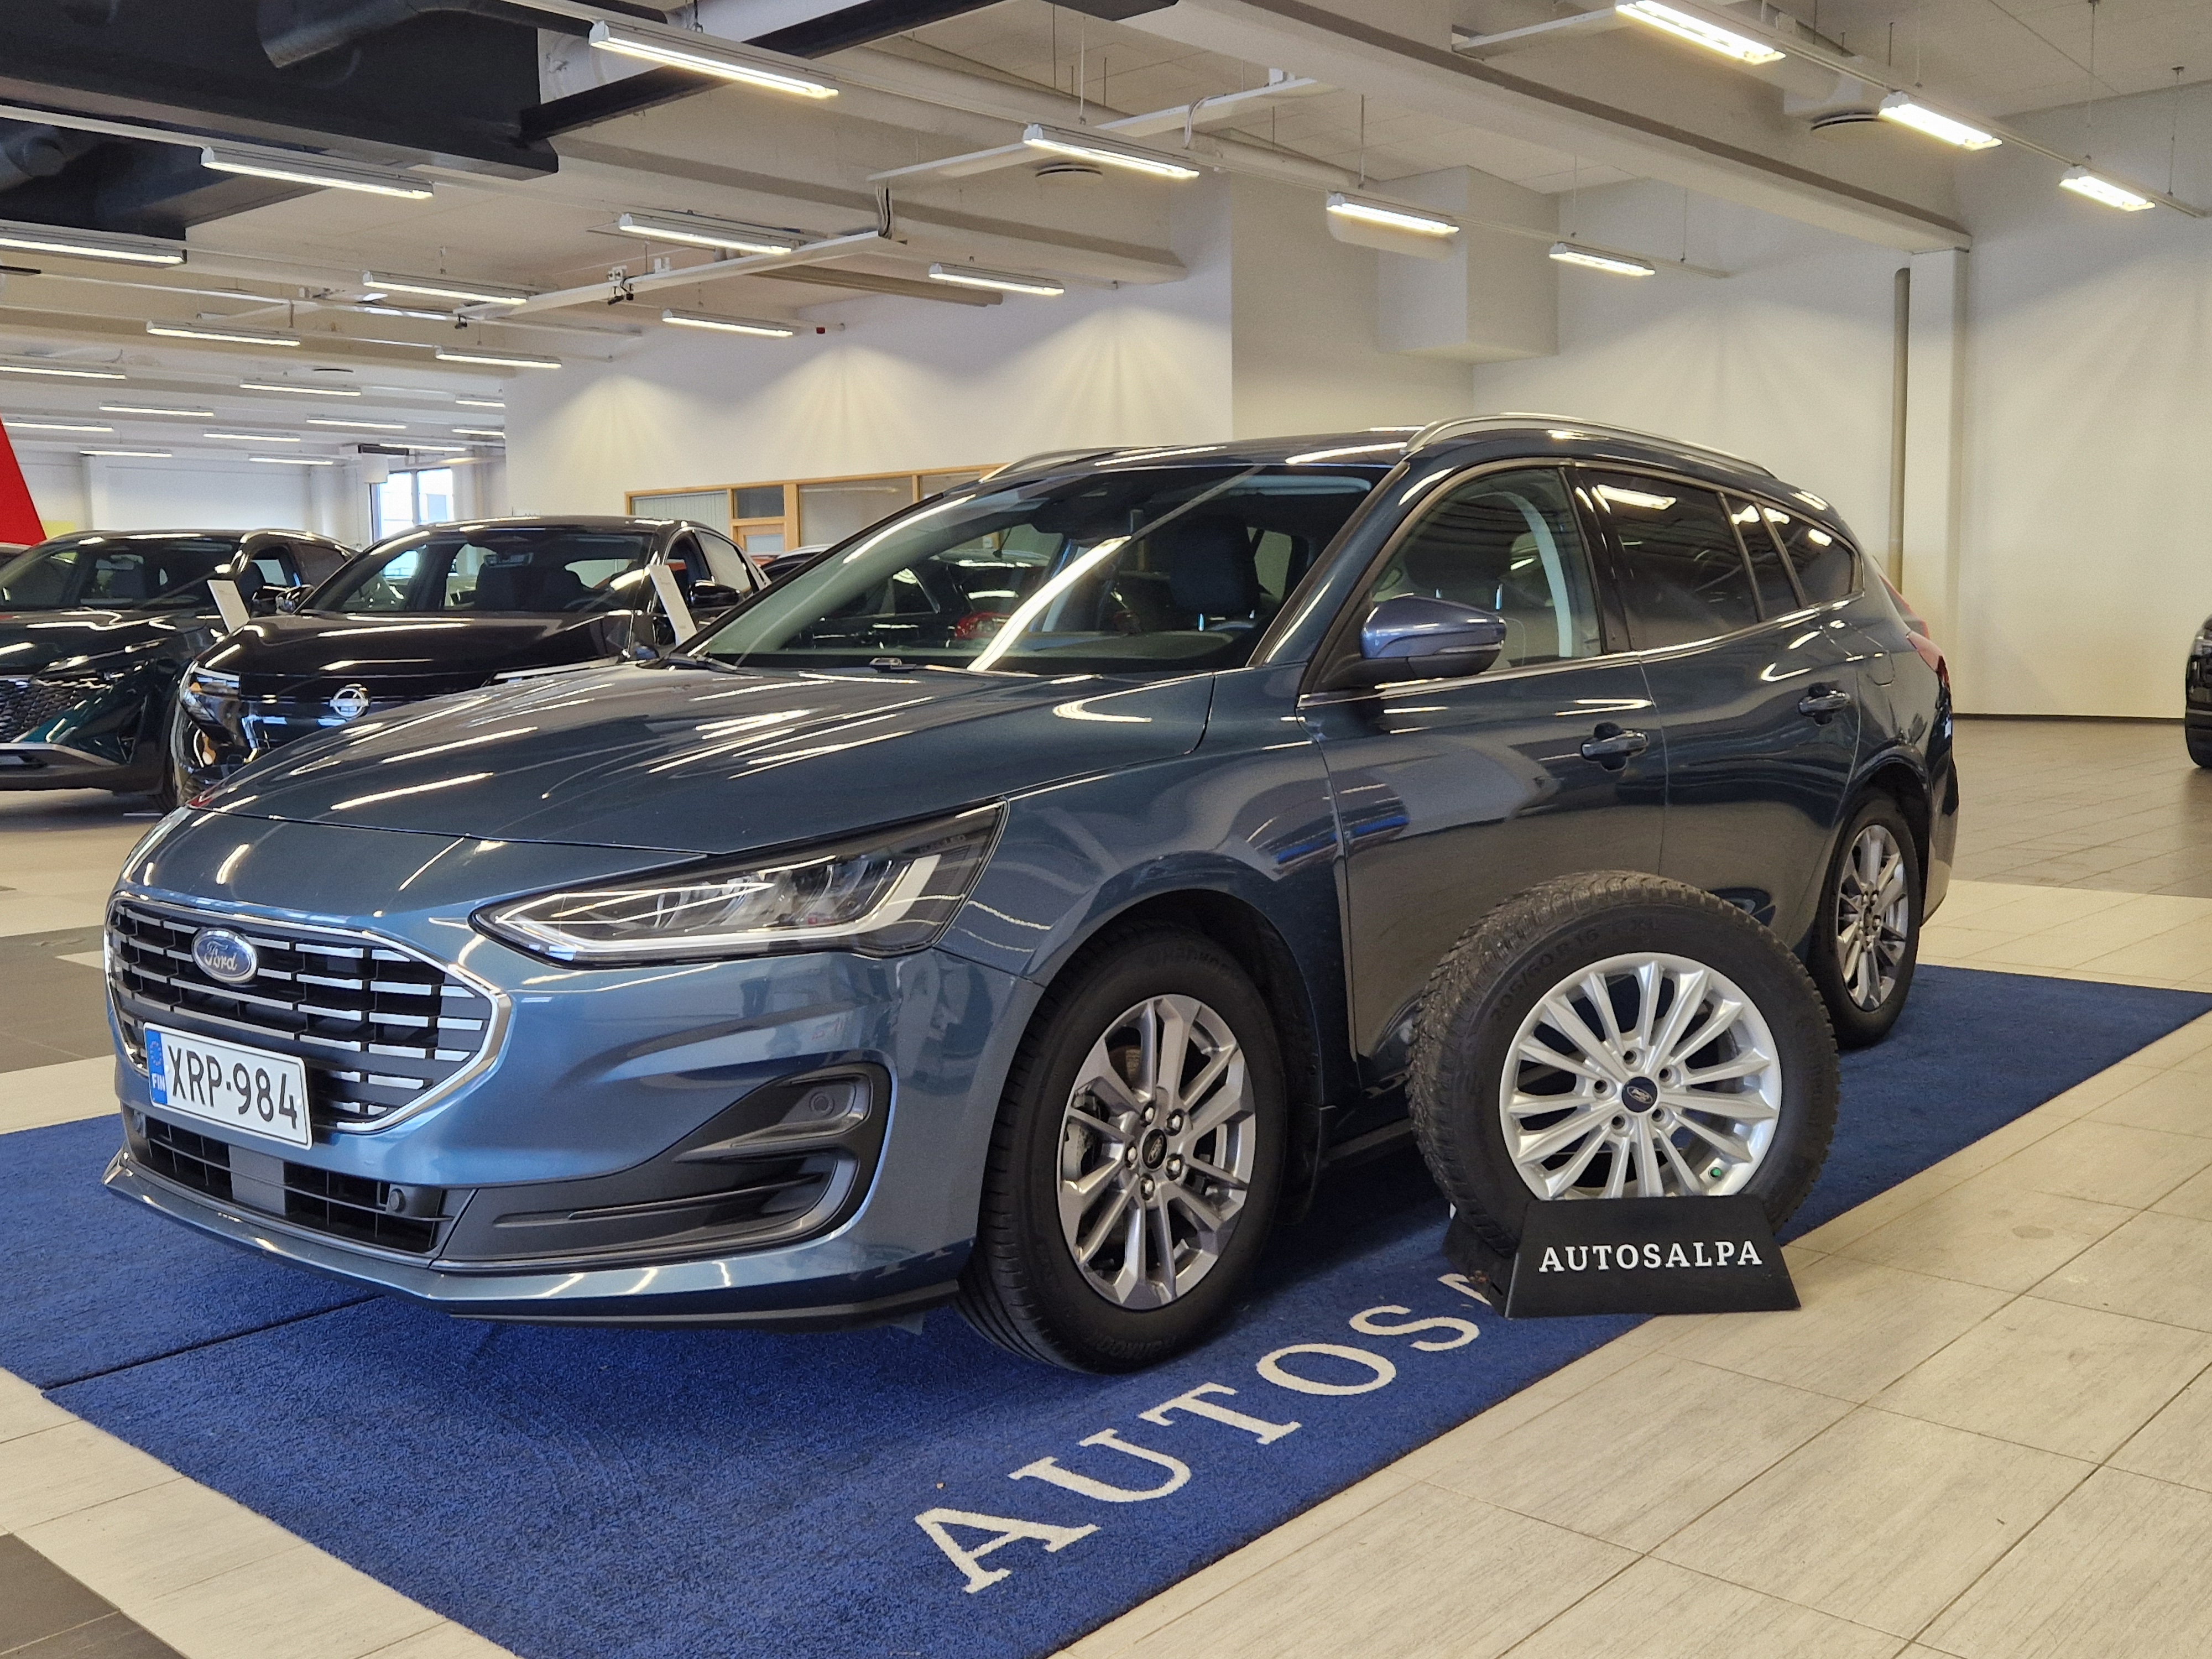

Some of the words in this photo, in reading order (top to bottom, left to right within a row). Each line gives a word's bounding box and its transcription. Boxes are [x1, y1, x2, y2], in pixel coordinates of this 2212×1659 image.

[204, 941, 237, 971] Ford
[152, 1073, 166, 1092] FIN
[168, 1045, 298, 1130] XRP-984
[1538, 1240, 1763, 1272] AUTOSALPA
